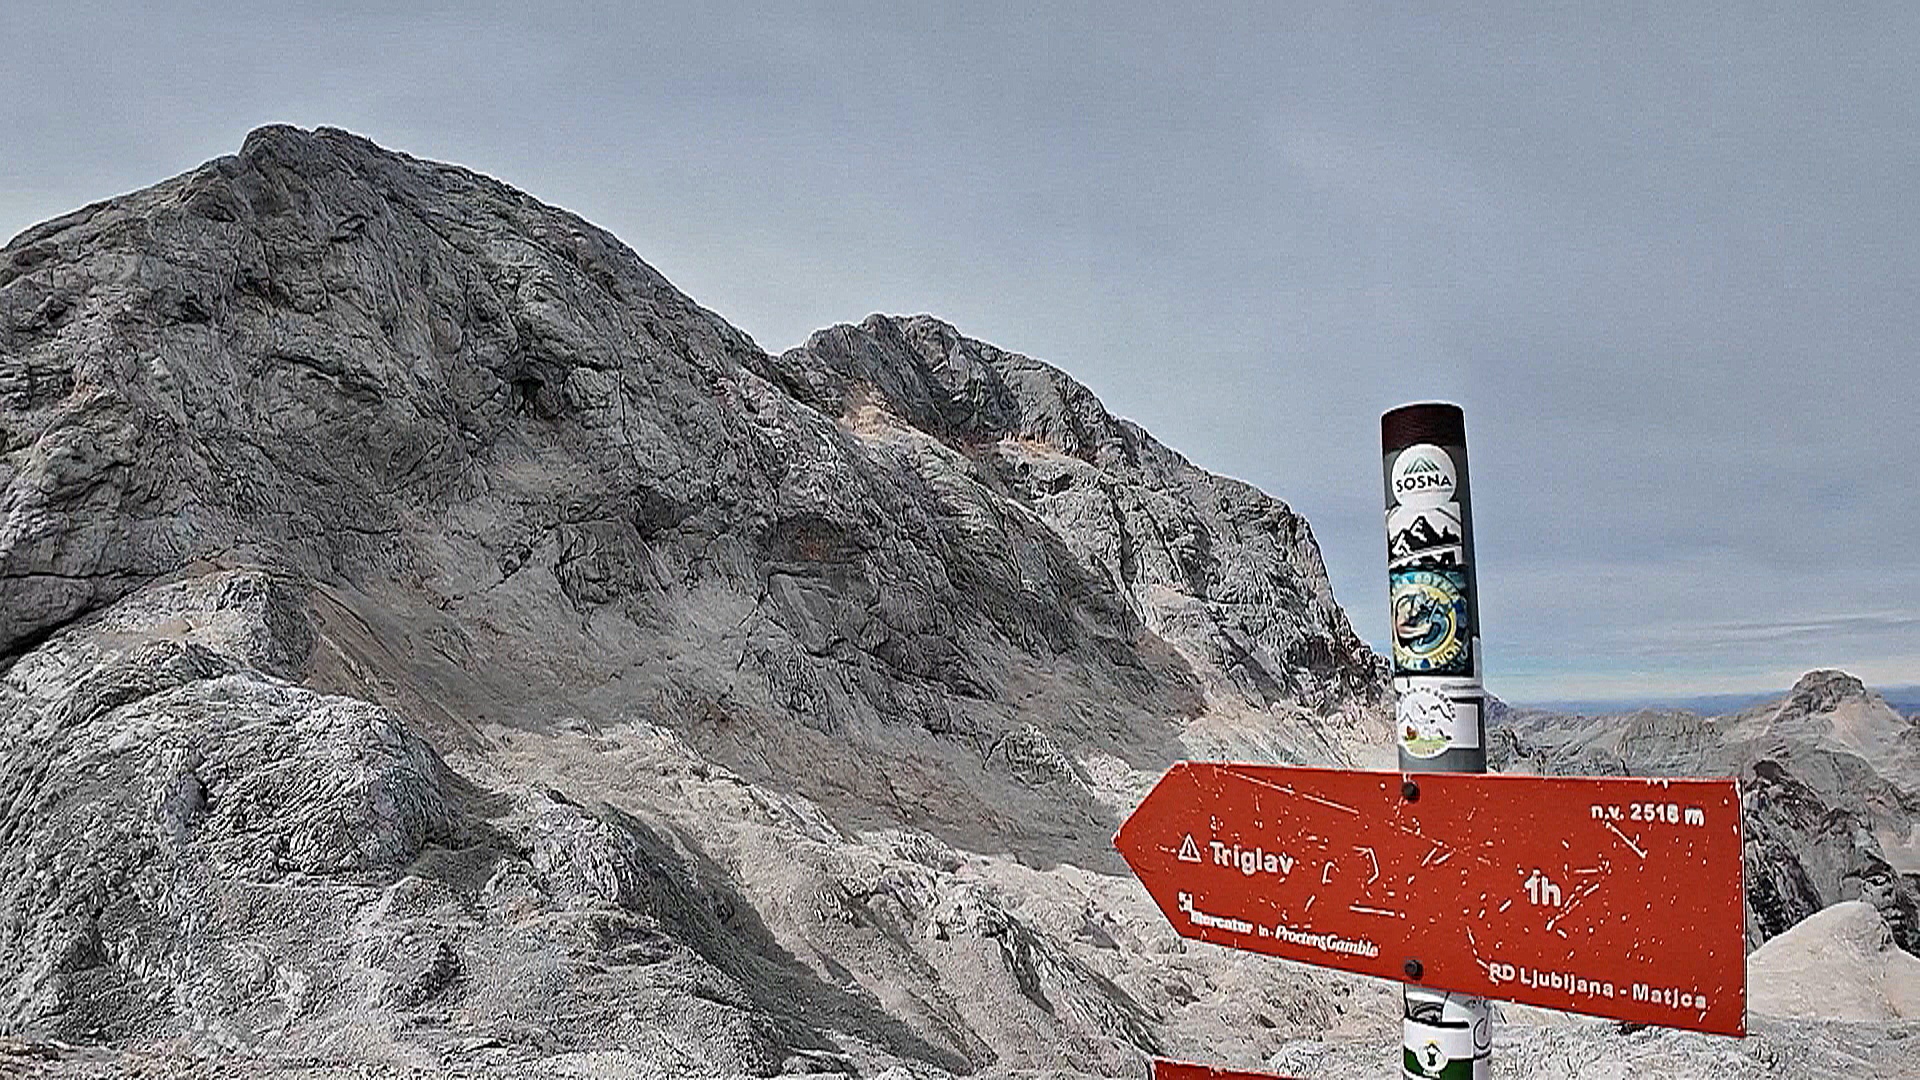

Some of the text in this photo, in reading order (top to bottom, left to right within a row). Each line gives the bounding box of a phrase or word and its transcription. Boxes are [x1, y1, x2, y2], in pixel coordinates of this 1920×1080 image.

[1396, 474, 1453, 493] SOSNA
[1684, 808, 1705, 826] m
[1209, 841, 1294, 876] Triglav
[1520, 967, 1614, 998] Ljubljana
